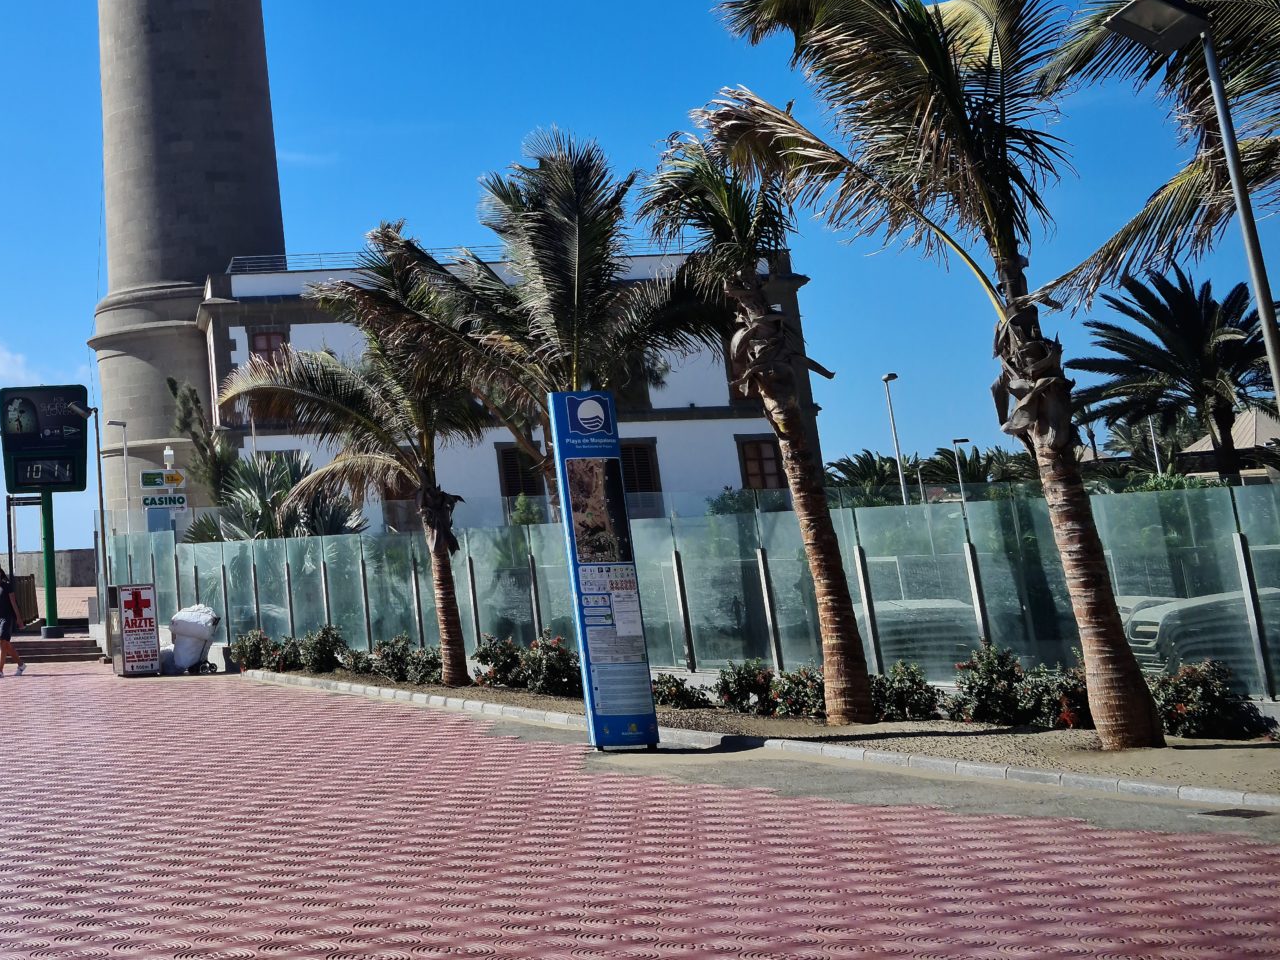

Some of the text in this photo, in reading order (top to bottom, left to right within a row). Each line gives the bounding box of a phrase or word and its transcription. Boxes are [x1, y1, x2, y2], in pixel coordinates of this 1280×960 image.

[26, 464, 70, 479] 10 11
[143, 496, 185, 506] CASINO
